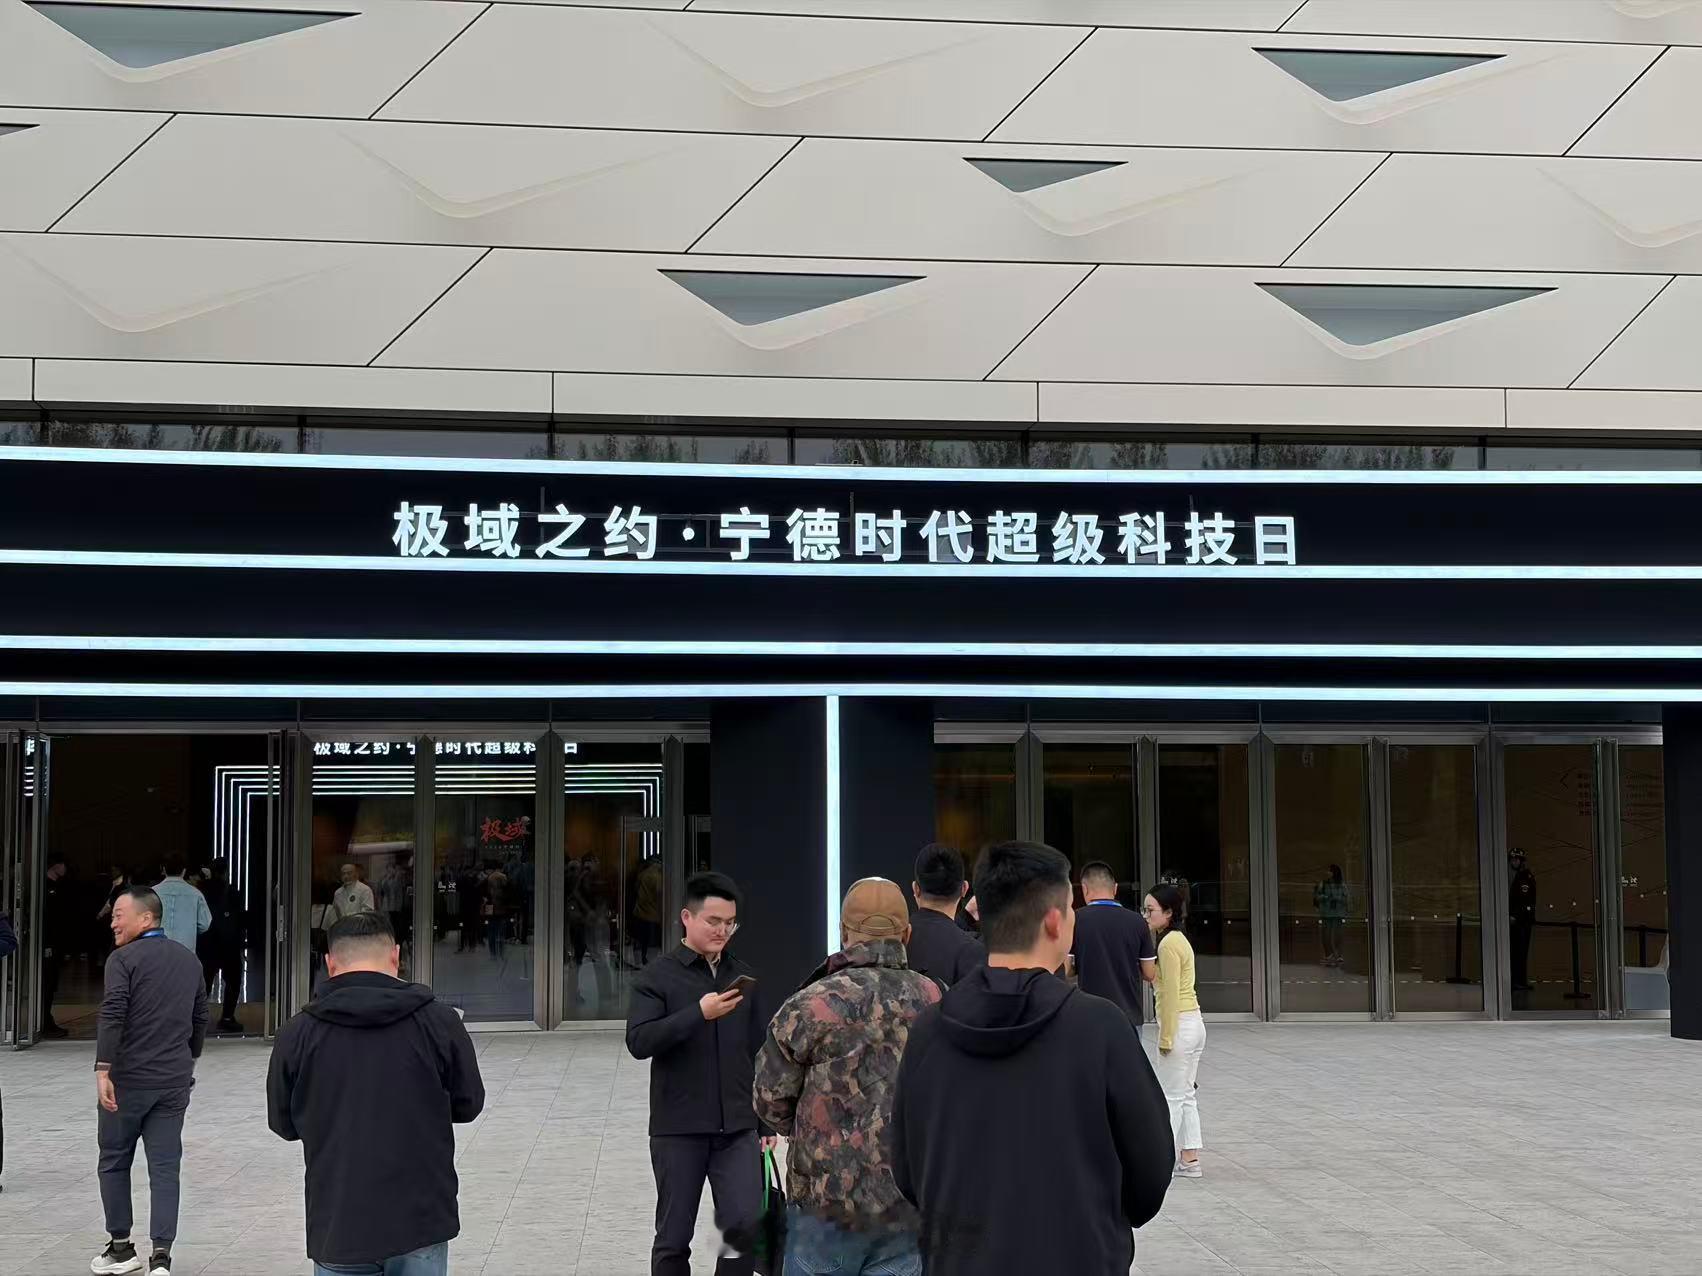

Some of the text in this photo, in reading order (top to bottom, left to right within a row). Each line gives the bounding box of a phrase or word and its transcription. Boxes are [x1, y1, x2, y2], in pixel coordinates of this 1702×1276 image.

[392, 501, 1297, 565] 极域之约·宁德时代超级科技日
